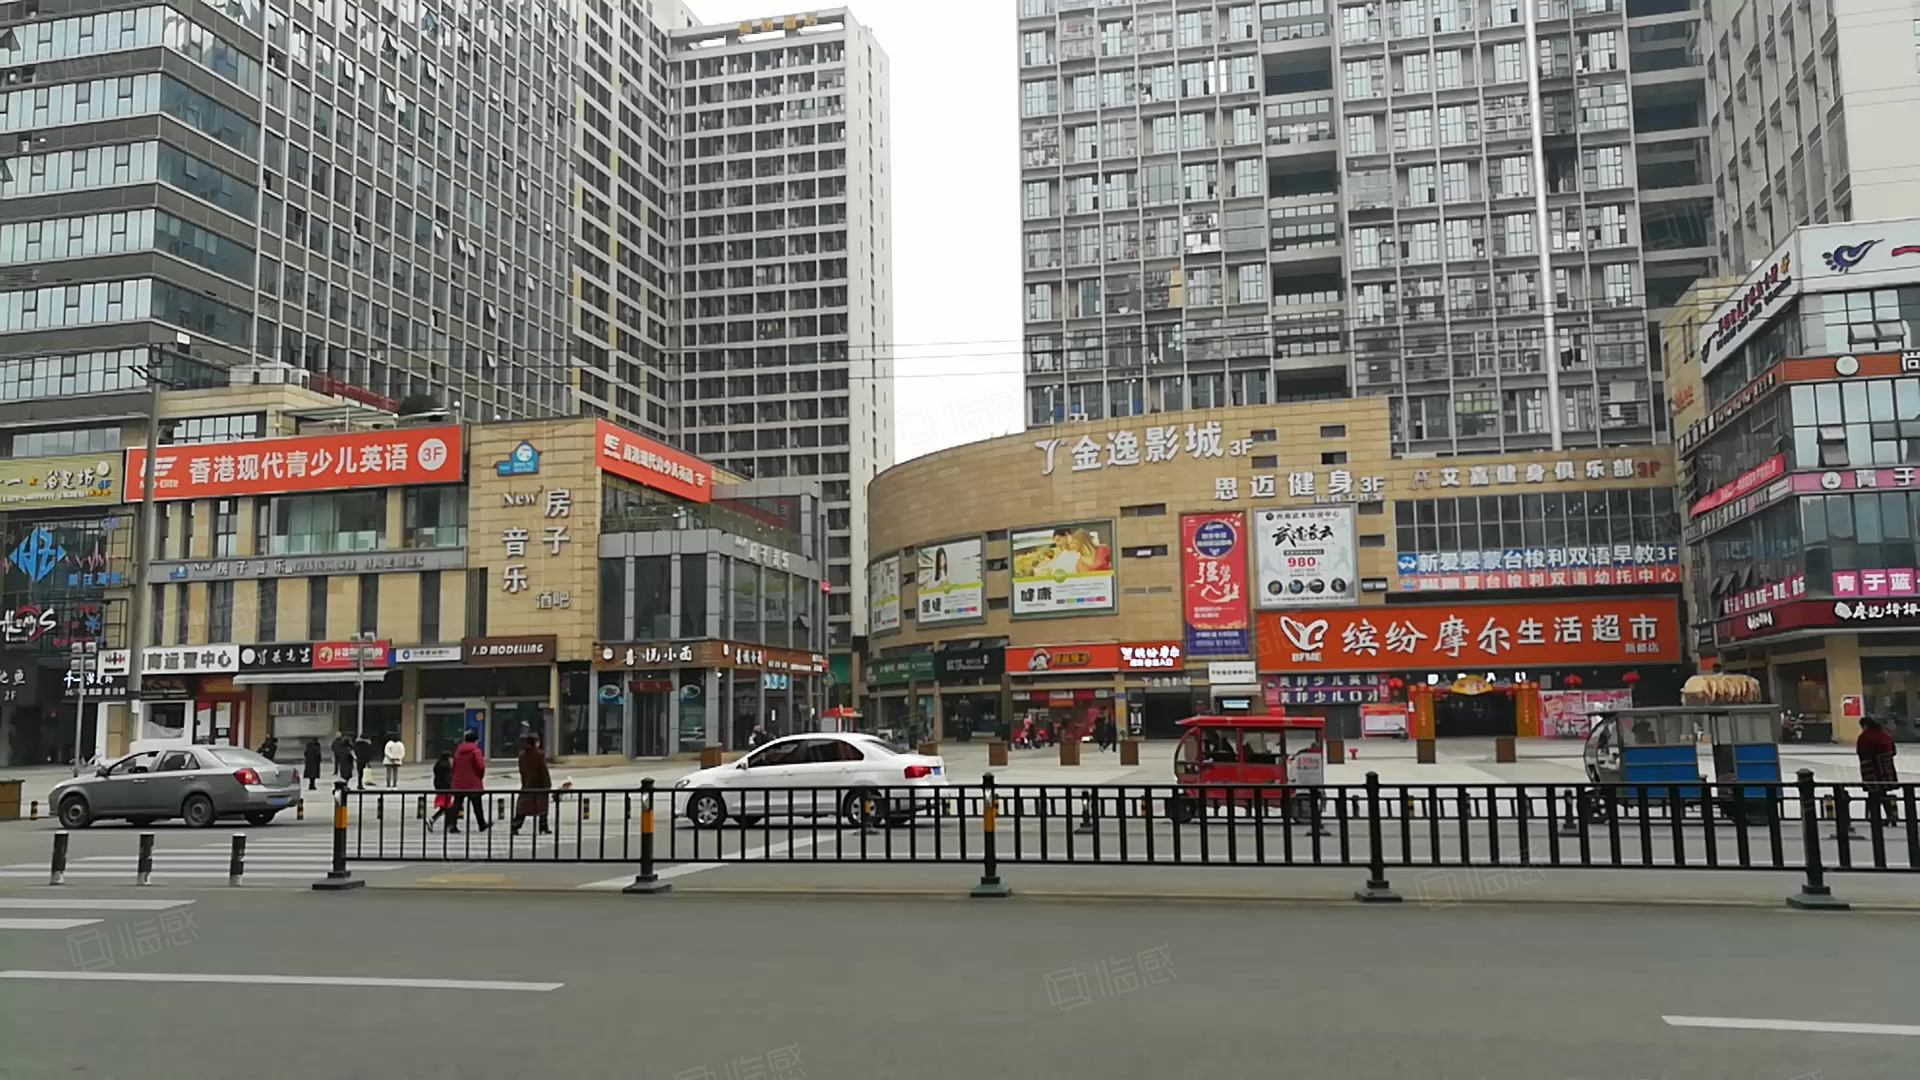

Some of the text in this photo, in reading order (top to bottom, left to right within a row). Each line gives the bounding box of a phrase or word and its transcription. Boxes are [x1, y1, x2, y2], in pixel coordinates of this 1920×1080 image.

[189, 443, 408, 484] 香港现代青少儿英语
[422, 447, 443, 462] 3F
[502, 485, 544, 508] New
[1287, 556, 1316, 567] 980
[1341, 613, 1659, 658] 缤纷摩尔生活超市
